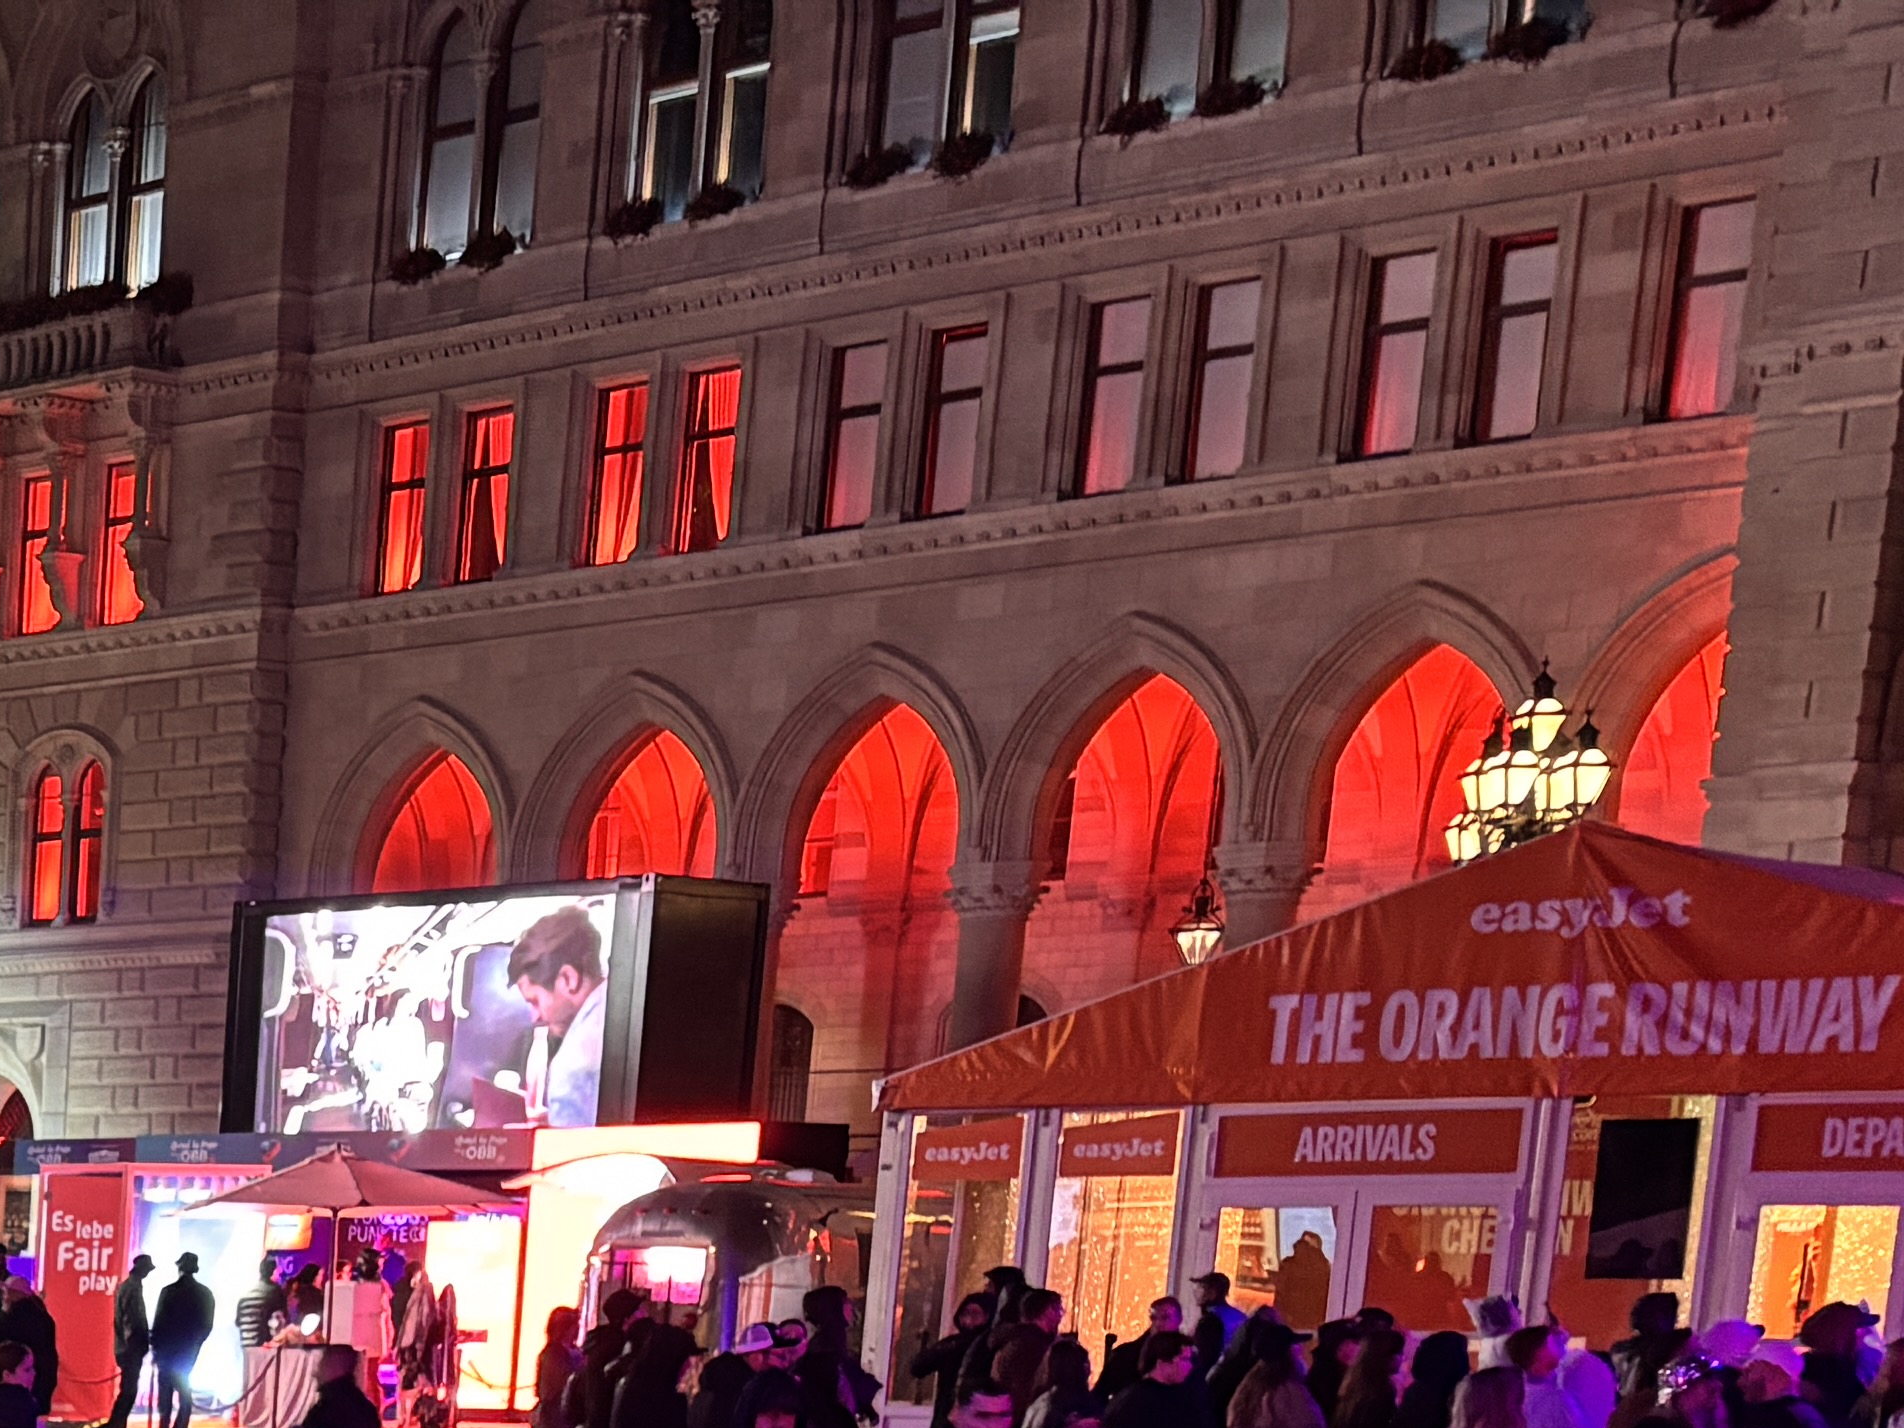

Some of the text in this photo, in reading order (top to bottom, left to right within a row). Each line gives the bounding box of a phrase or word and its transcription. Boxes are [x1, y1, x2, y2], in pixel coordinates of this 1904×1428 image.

[1469, 887, 1692, 939] easyJet
[1269, 974, 1902, 1065] THE ORANGE RUNWAY
[924, 1139, 1011, 1165] easyJet
[1072, 1136, 1165, 1161] easyJet
[1294, 1123, 1438, 1163] ARRIVALS
[52, 1210, 114, 1239] Es lebe
[57, 1240, 114, 1272] Fair
[78, 1272, 119, 1296] play
